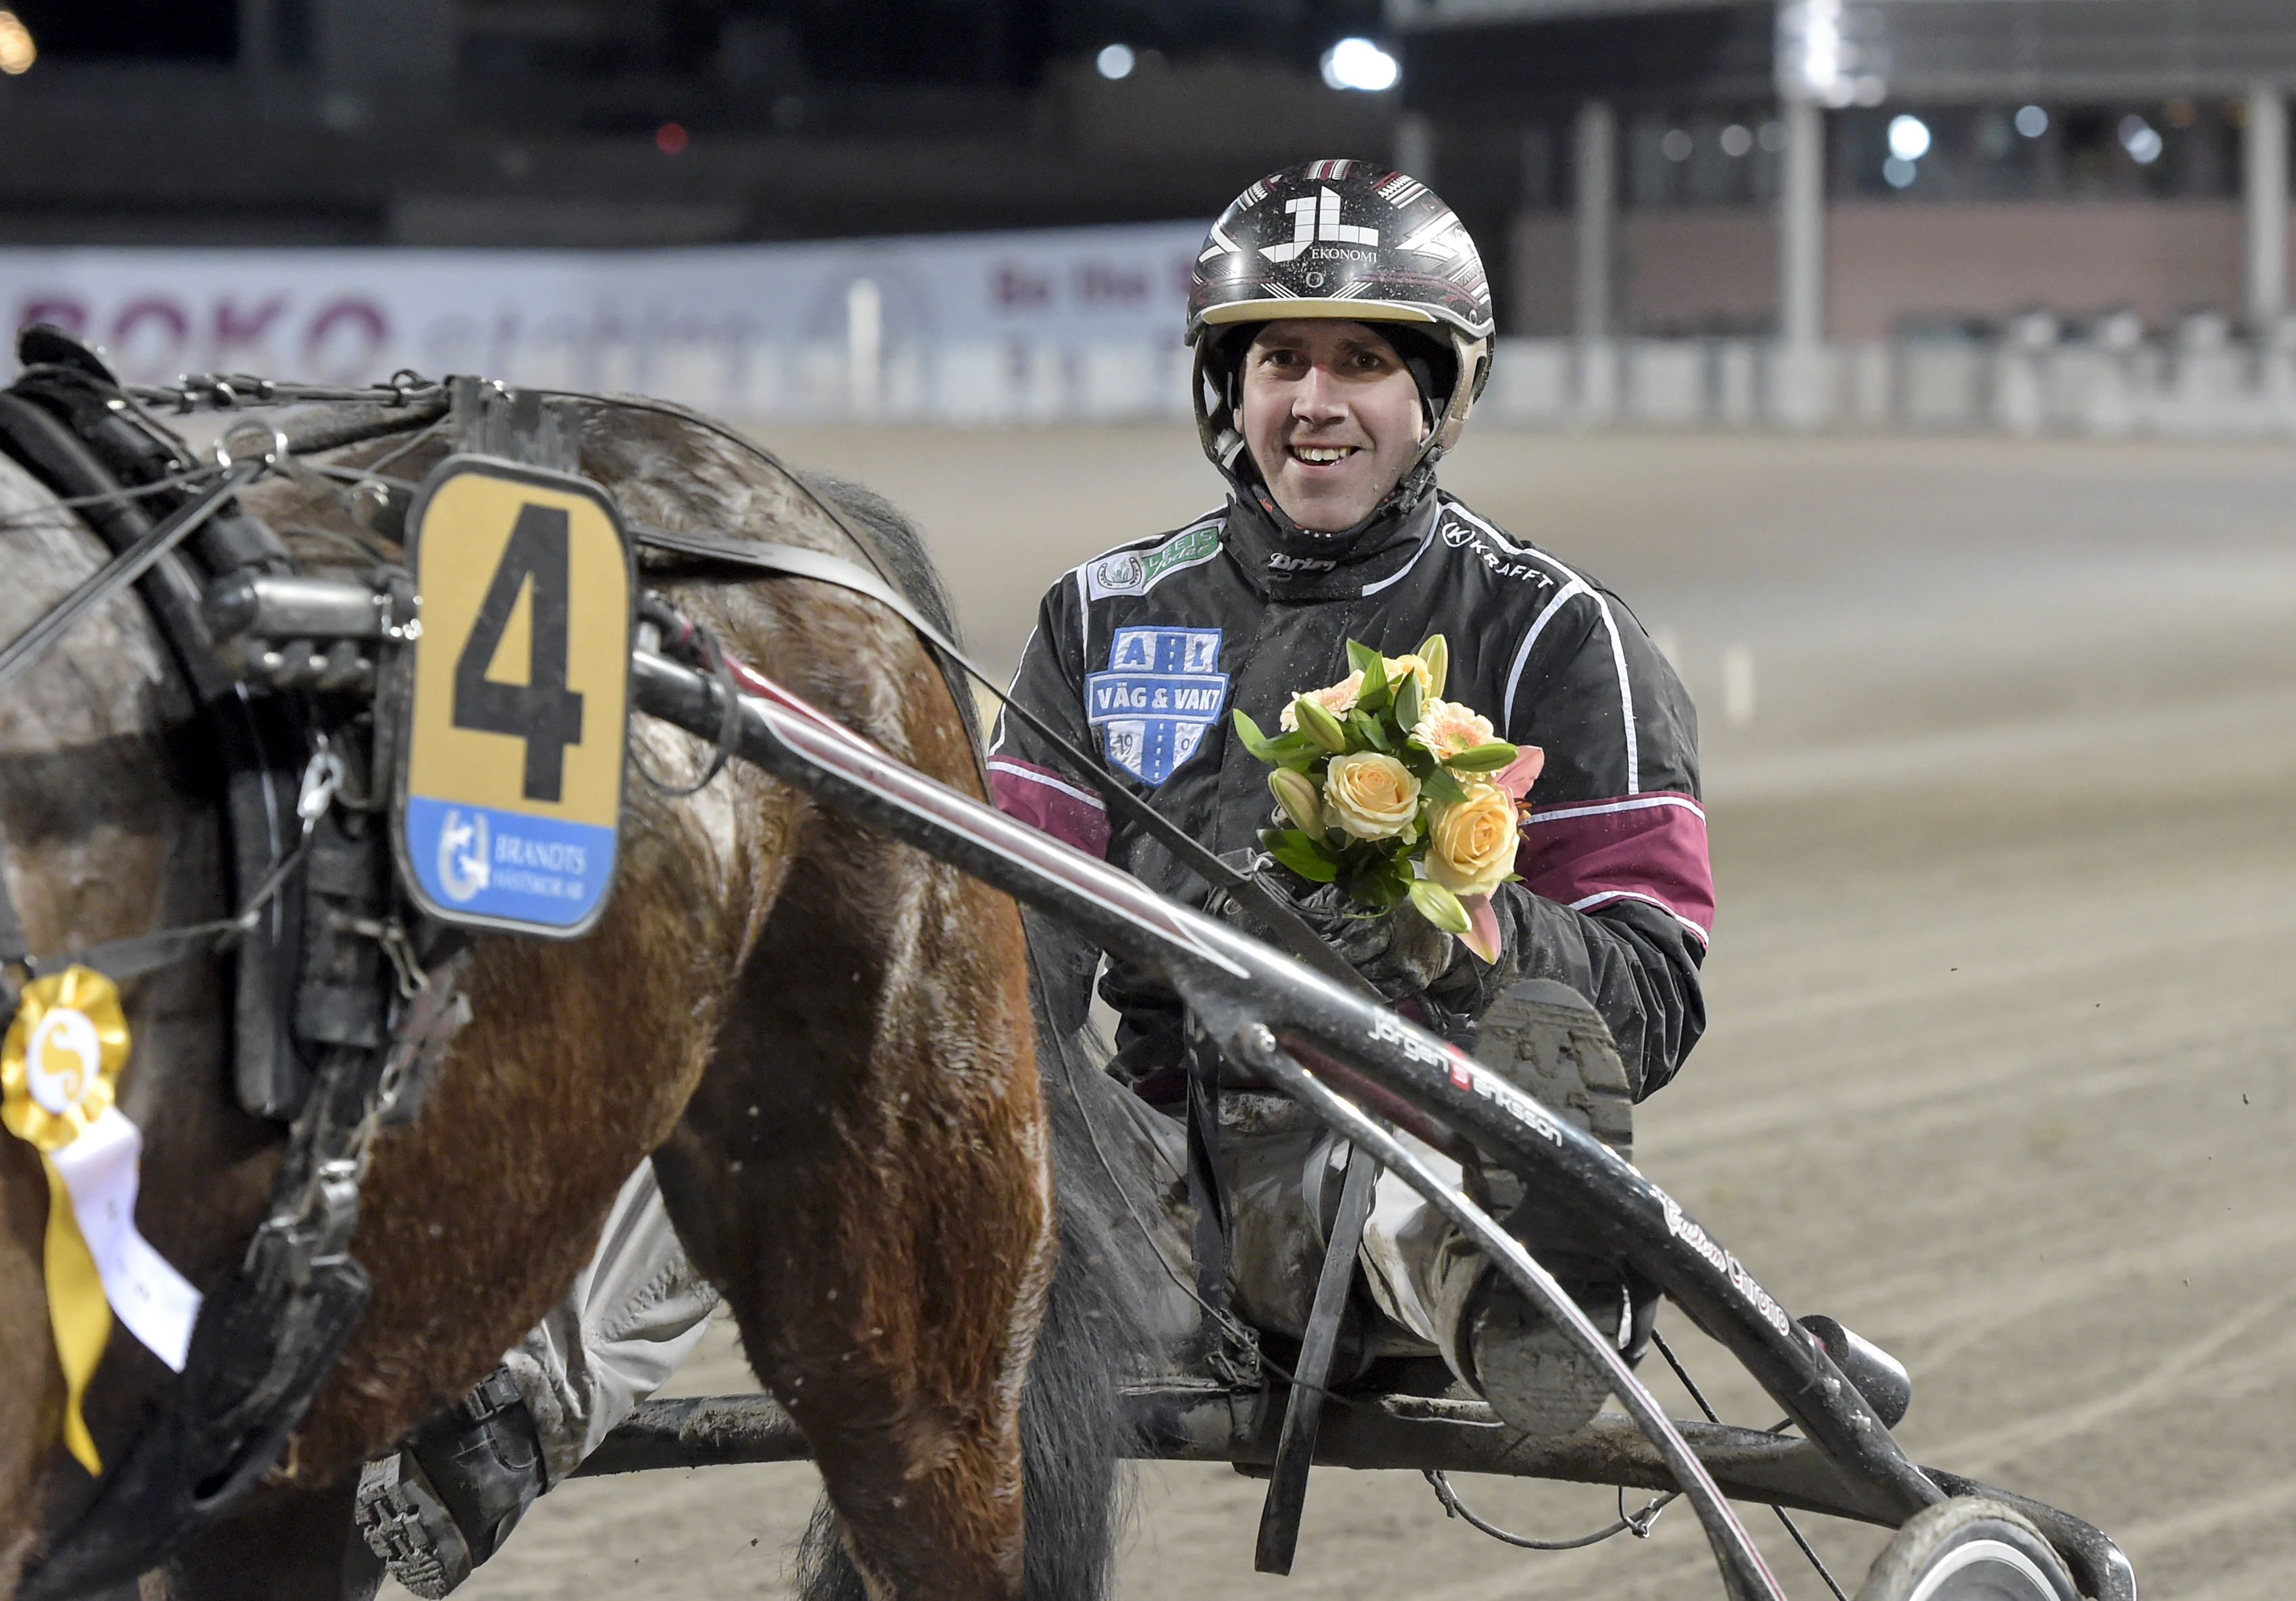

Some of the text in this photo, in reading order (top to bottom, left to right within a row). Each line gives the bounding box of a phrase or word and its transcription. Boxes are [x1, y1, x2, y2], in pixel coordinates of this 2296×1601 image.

[1258, 185, 1379, 263] JL
[1311, 248, 1377, 263] EKONOMI
[1469, 539, 1554, 589] KRAFFT
[450, 501, 584, 803] 4
[1097, 682, 1221, 711] VÄG & VAKT
[1117, 734, 1133, 755] 19
